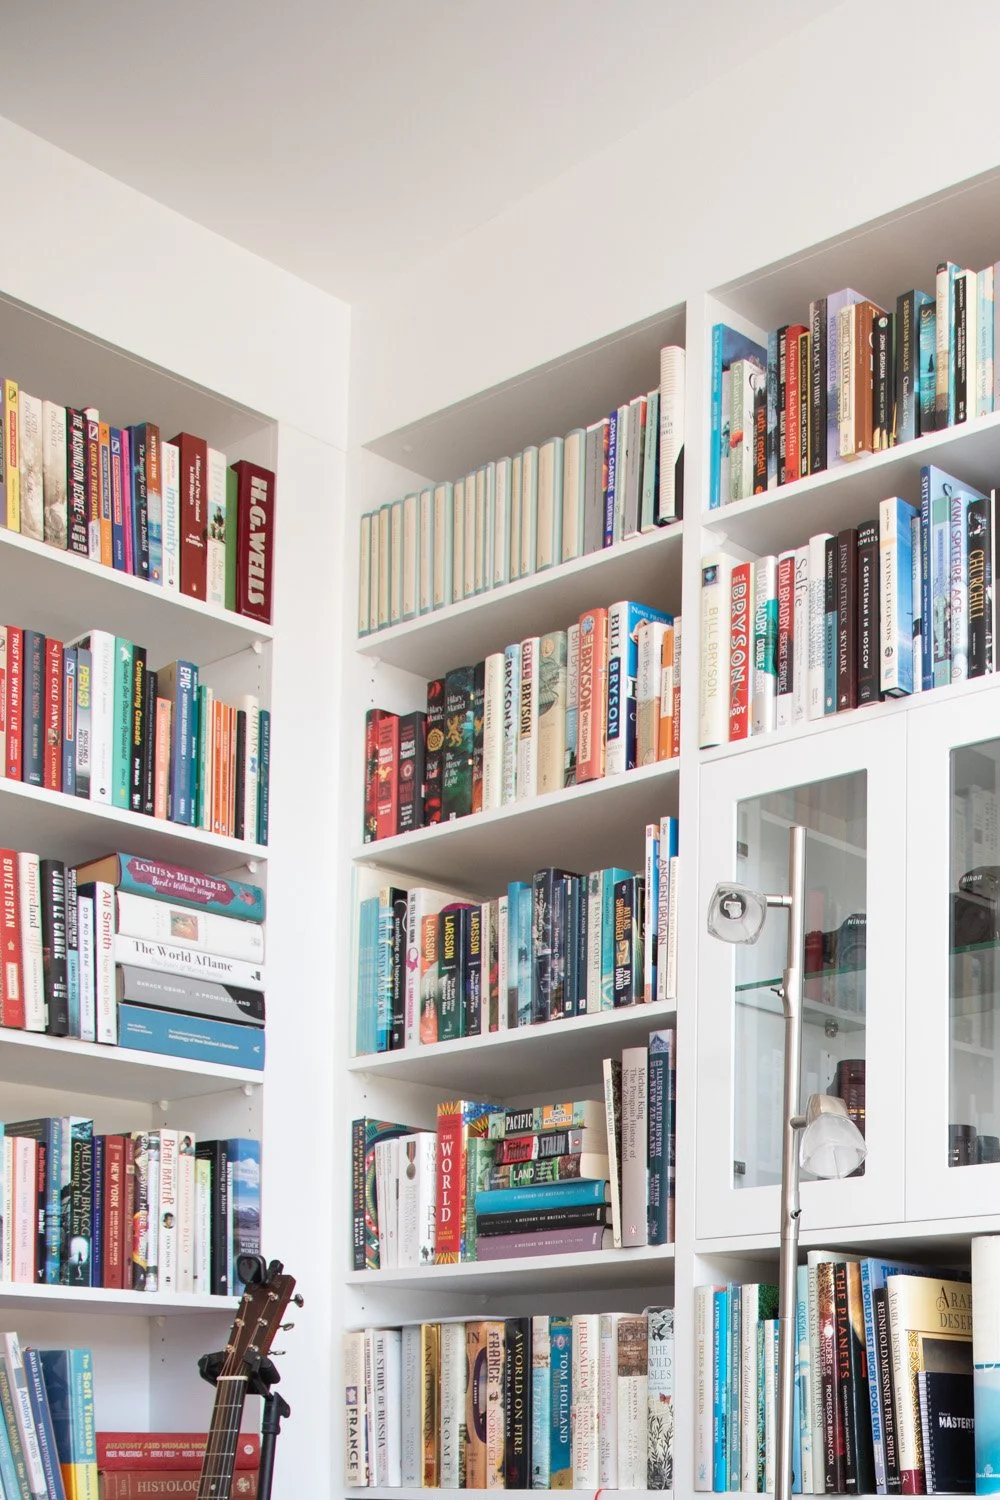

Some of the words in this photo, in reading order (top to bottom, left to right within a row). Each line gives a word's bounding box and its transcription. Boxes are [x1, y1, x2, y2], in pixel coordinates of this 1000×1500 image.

[73, 415, 83, 427] THE
[72, 429, 85, 481] WASHINGTON
[73, 484, 85, 513] DECREE
[610, 613, 620, 656] BILL
[731, 584, 747, 684] BRYSON
[134, 661, 143, 710] Conquering
[581, 646, 592, 712] BRYSON
[608, 663, 619, 736] BRYSON
[134, 712, 143, 745] Cascade
[3, 859, 15, 928] SOVIETISTAN
[29, 861, 40, 929] Empireland
[961, 873, 983, 884] Nikon
[102, 890, 112, 910] Ali
[103, 911, 112, 950] Smith
[444, 915, 454, 959] LARSSON
[470, 911, 479, 956] LARSSON
[615, 898, 624, 941] SHRUGGED
[623, 906, 632, 934] ATLAS
[134, 941, 155, 956] The
[158, 946, 191, 963] World
[194, 956, 232, 972] Aflame
[425, 917, 436, 962] LARSSON
[615, 967, 624, 990] RAND
[623, 967, 631, 986] AYN
[505, 1110, 533, 1131] PACIFIC
[163, 1138, 175, 1165] BEAU
[111, 1162, 119, 1180] NEW
[163, 1168, 175, 1205] BAXTER
[440, 1141, 453, 1222] WORLD
[110, 1183, 119, 1208] YORK
[836, 1270, 845, 1291] THE
[837, 1307, 849, 1377] PLANETS
[514, 1340, 522, 1391] WORLD
[560, 1353, 568, 1379] TOM
[83, 1371, 92, 1399] Soft
[514, 1397, 522, 1414] ON
[560, 1382, 568, 1444] HOLLAND
[84, 1404, 94, 1455] Tissues
[349, 1408, 358, 1470] FRANCE
[514, 1424, 522, 1455] FIRE
[137, 1480, 200, 1492] HISTOLOG
